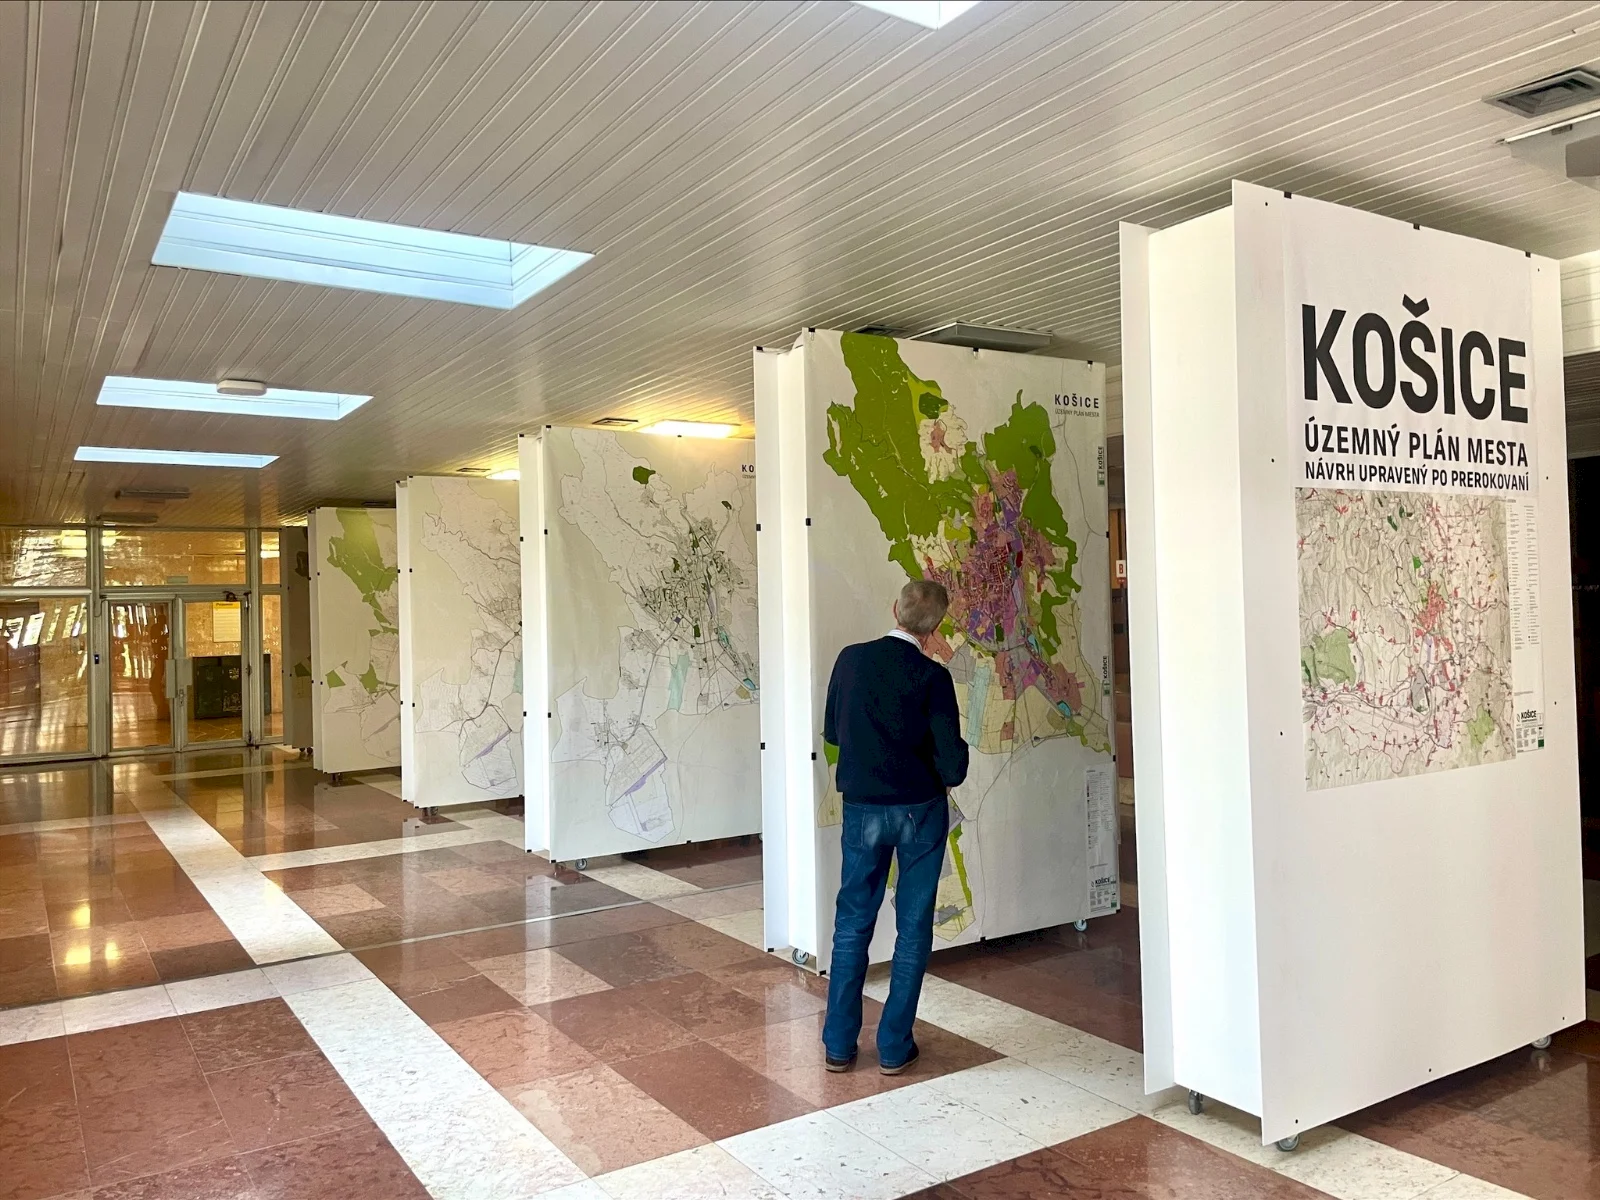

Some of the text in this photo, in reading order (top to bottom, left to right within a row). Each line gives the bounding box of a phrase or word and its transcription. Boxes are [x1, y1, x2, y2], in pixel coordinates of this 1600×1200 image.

[1302, 294, 1529, 424] KOŠICE
[1054, 393, 1099, 409] KOŠICE
[1305, 416, 1529, 468] ÚZEMNÝ PLÁN MESTA
[741, 464, 755, 473] KO
[1305, 458, 1529, 491] NÁVRH UPRAVENÝ PO PREROKOVANÍ
